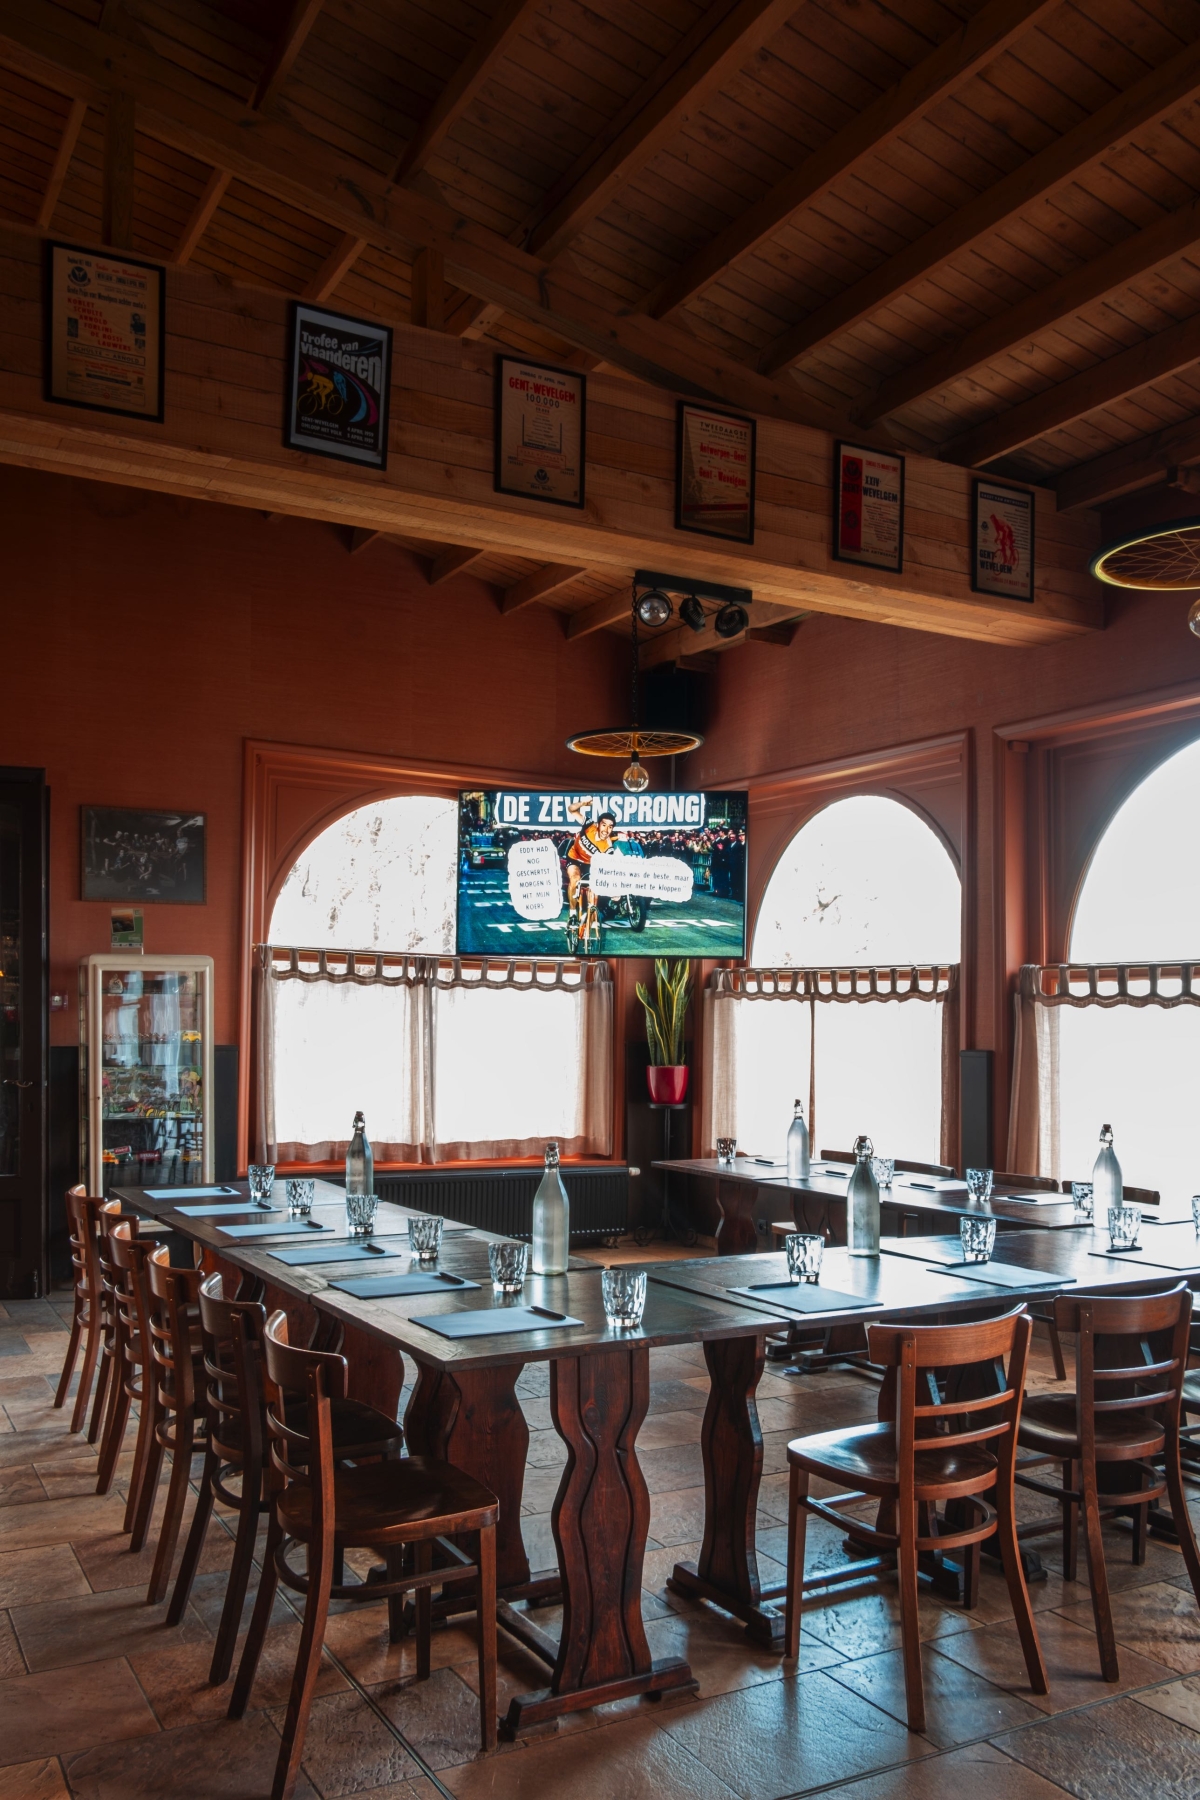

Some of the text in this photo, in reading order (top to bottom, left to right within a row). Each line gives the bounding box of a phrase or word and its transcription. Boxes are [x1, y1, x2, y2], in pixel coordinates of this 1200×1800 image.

[68, 298, 95, 308] KOBLET
[74, 306, 103, 317] SCHULTE
[79, 314, 108, 325] ARNOLD
[98, 340, 131, 351] LAUWERS
[301, 331, 358, 351] Trofee van
[301, 341, 382, 394] Vlaanderen
[509, 377, 576, 404] GENT-WEVELGEM
[301, 422, 320, 431] OMLOOP
[351, 427, 363, 435] APRIL
[700, 422, 747, 437] TWEEDAAGSE
[351, 433, 363, 442] APRIL
[862, 486, 898, 503] WEVELGEM
[980, 560, 1012, 575] WEVELGEM
[504, 796, 529, 822] DE
[598, 867, 626, 877] Maertens
[643, 870, 651, 879] de
[520, 880, 544, 888] MORGEN
[595, 879, 610, 888] Eddy
